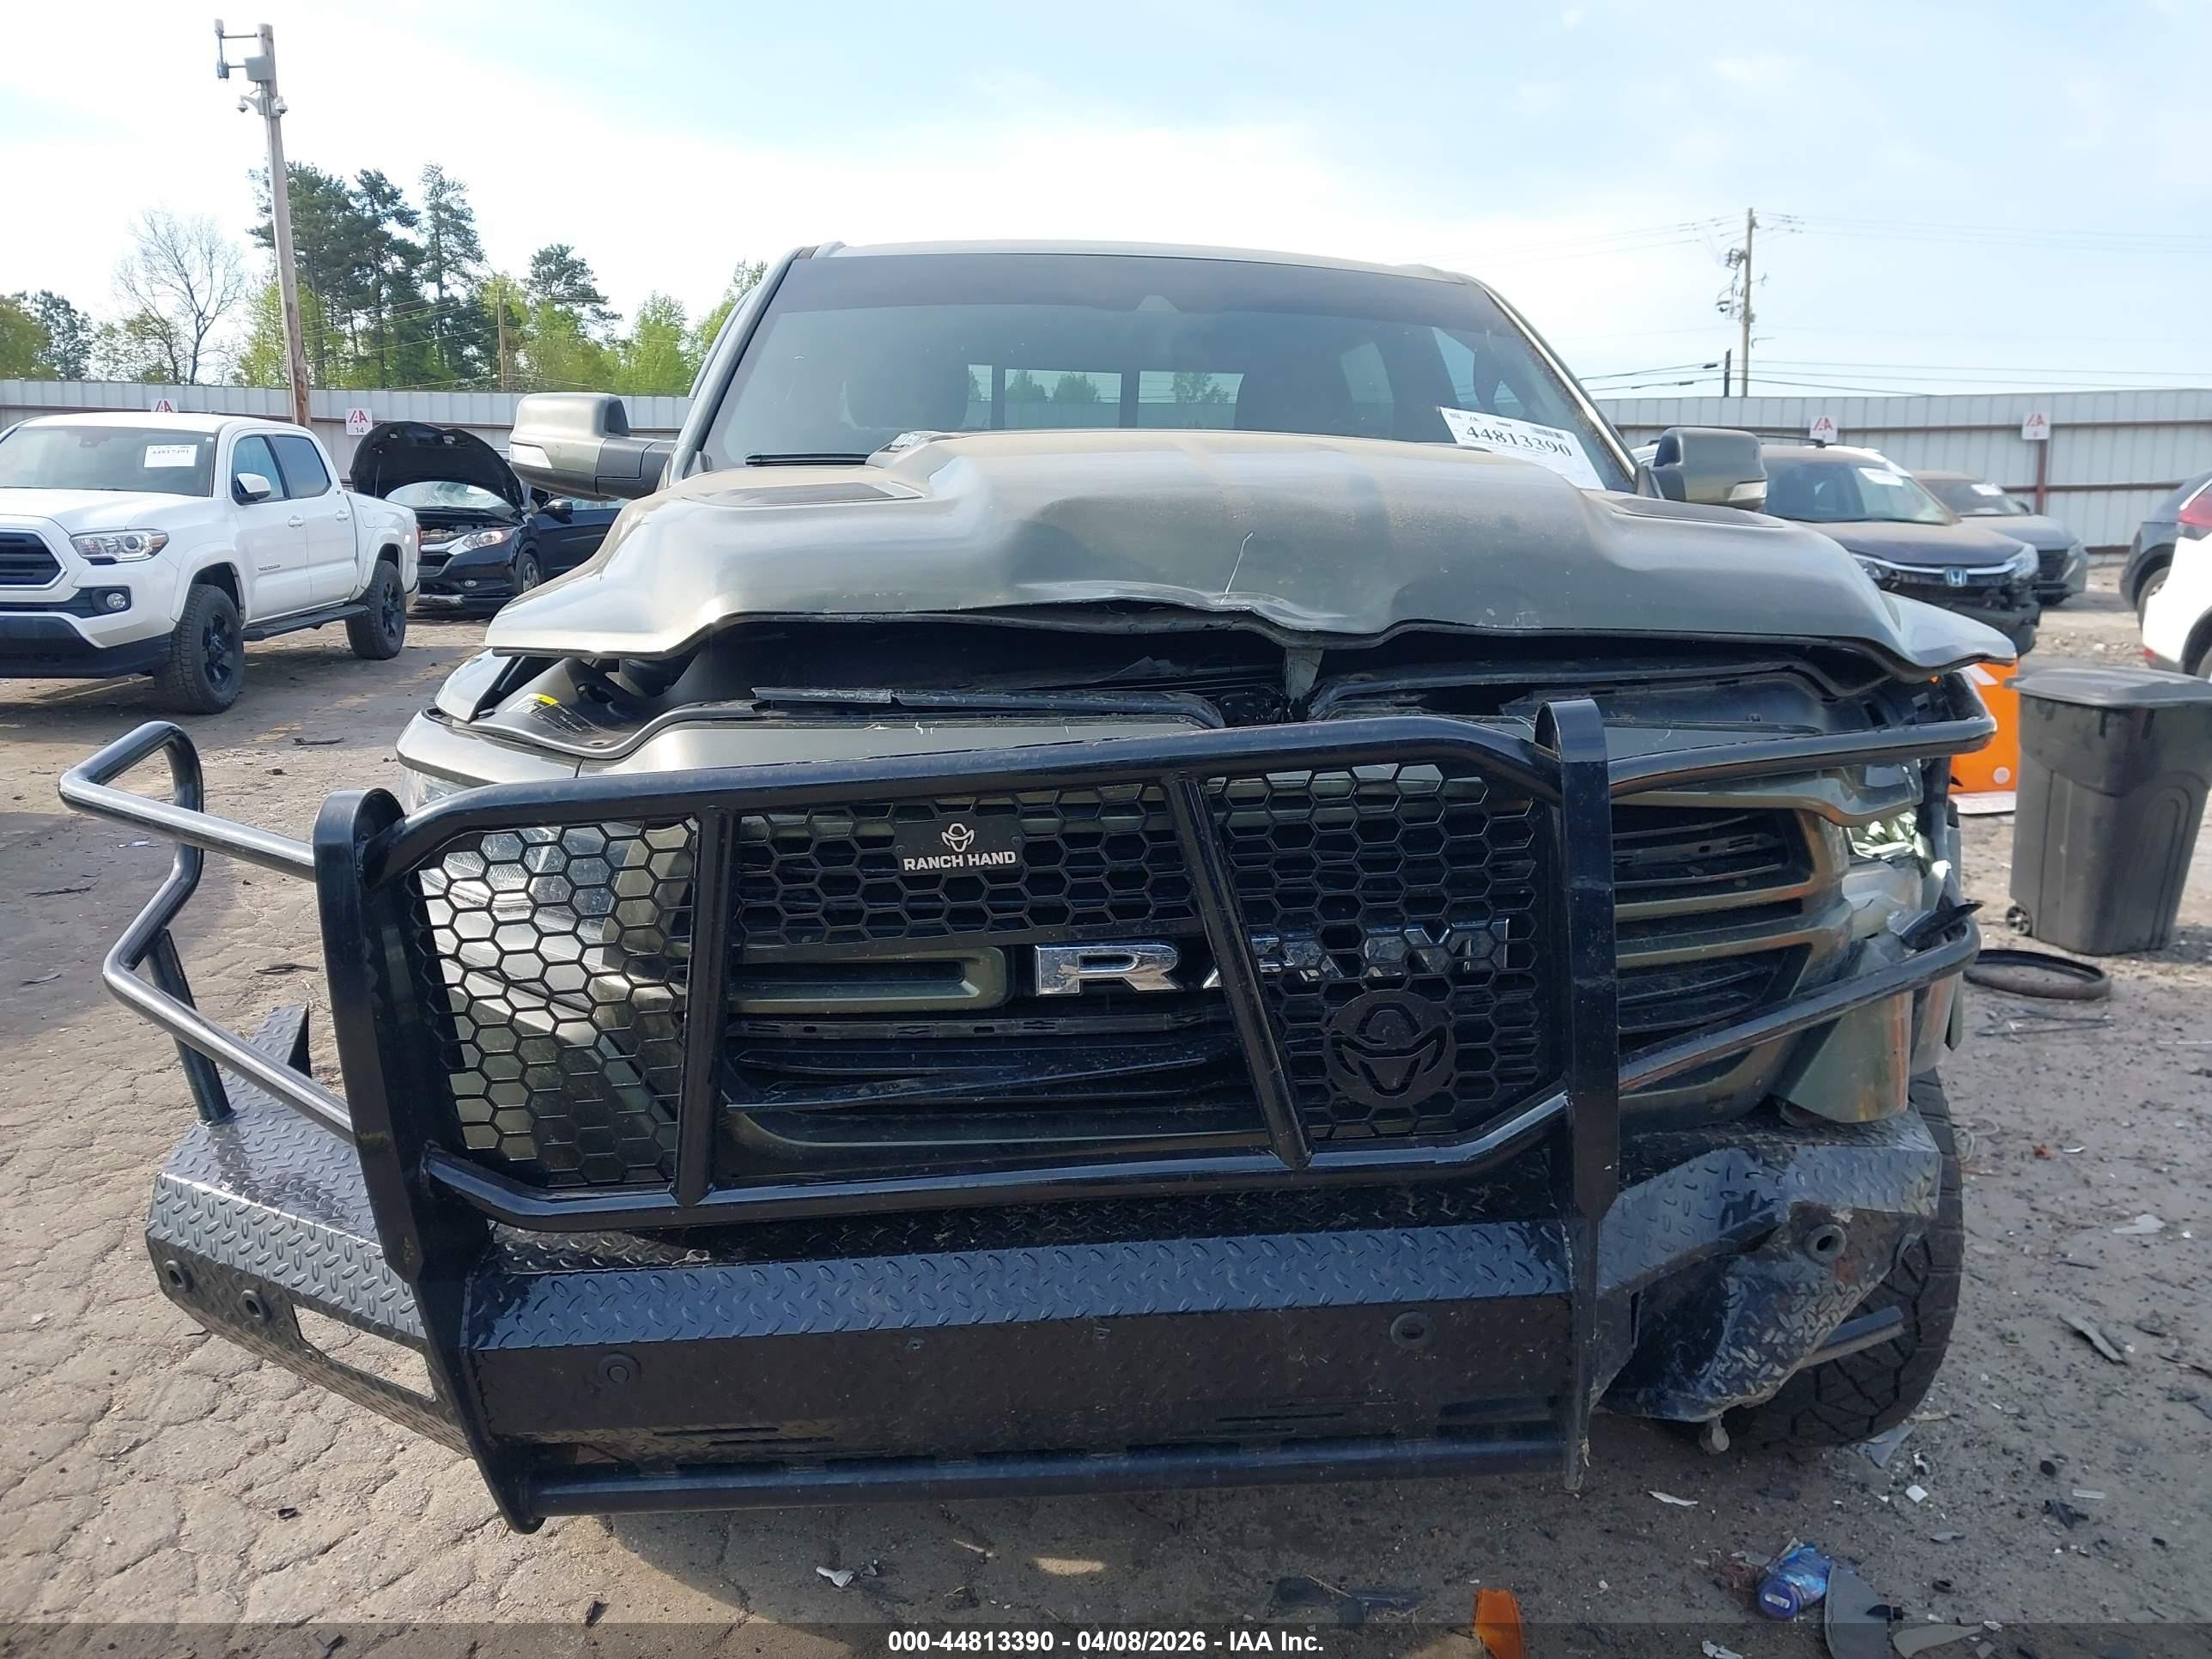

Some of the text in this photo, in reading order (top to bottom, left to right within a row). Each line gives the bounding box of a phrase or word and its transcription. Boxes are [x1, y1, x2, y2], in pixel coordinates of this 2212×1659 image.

[1466, 426, 1573, 458] 44813390
[903, 851, 1017, 871] RANCH HAND
[1035, 918, 1510, 995] RAM
